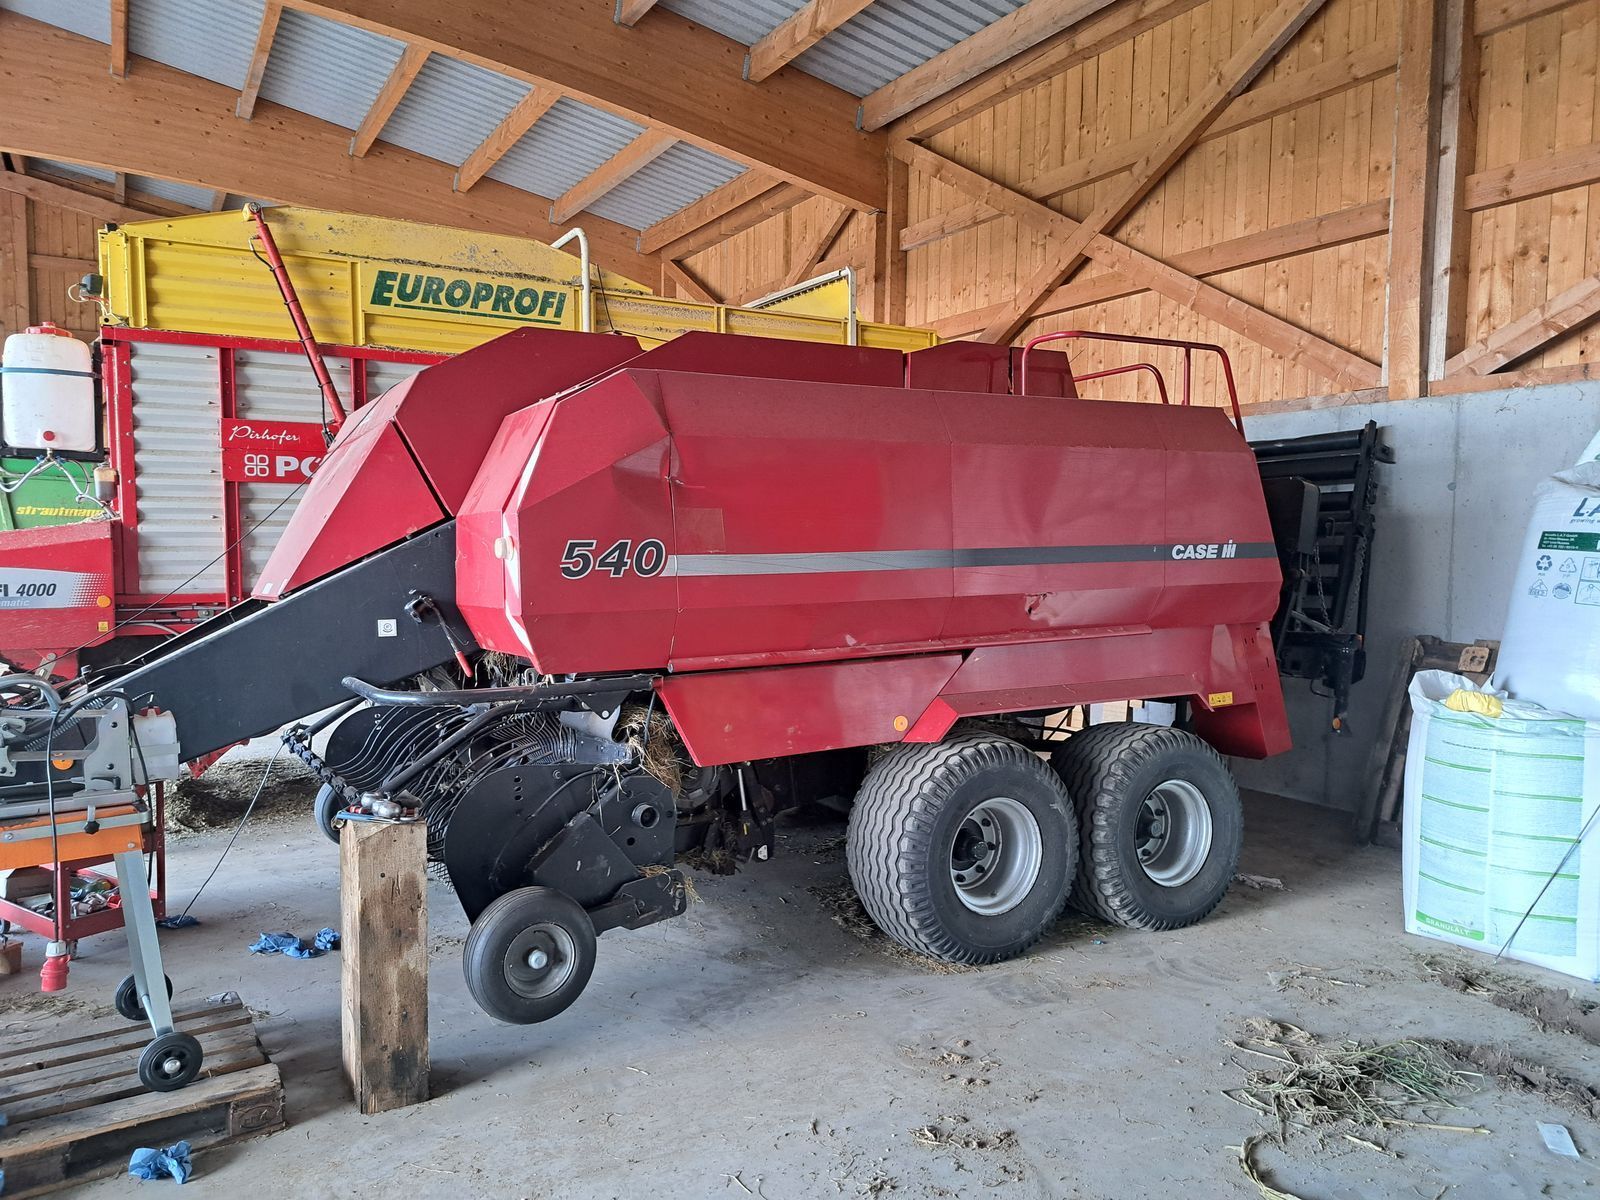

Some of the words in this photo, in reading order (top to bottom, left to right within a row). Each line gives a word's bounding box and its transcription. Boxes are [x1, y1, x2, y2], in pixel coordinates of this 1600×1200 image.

[370, 270, 567, 319] EUROPROFI
[228, 425, 299, 445] Pirhofer
[560, 538, 666, 579] 540
[1171, 543, 1219, 560] CASE
[16, 583, 57, 597] 4000
